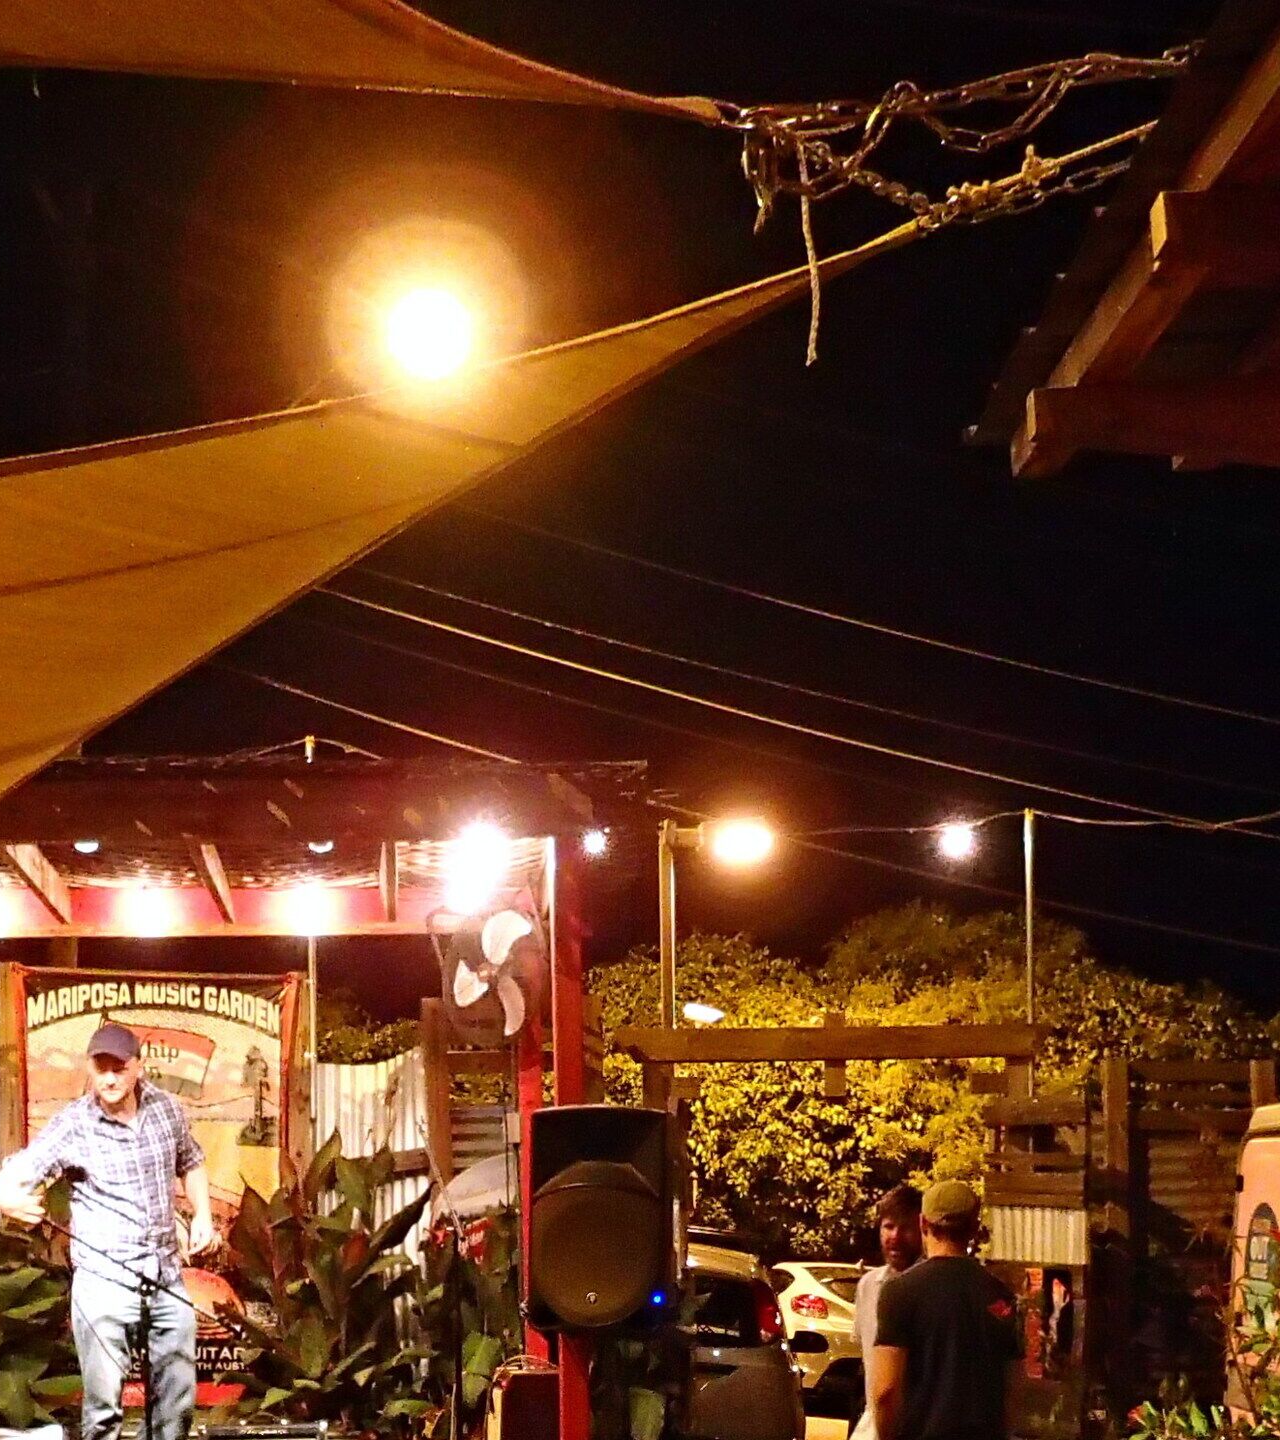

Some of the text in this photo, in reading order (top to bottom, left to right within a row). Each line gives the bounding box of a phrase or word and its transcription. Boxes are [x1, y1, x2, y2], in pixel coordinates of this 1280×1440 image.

[26, 981, 281, 1035] MARIPOSA MUSIC GARDEN
